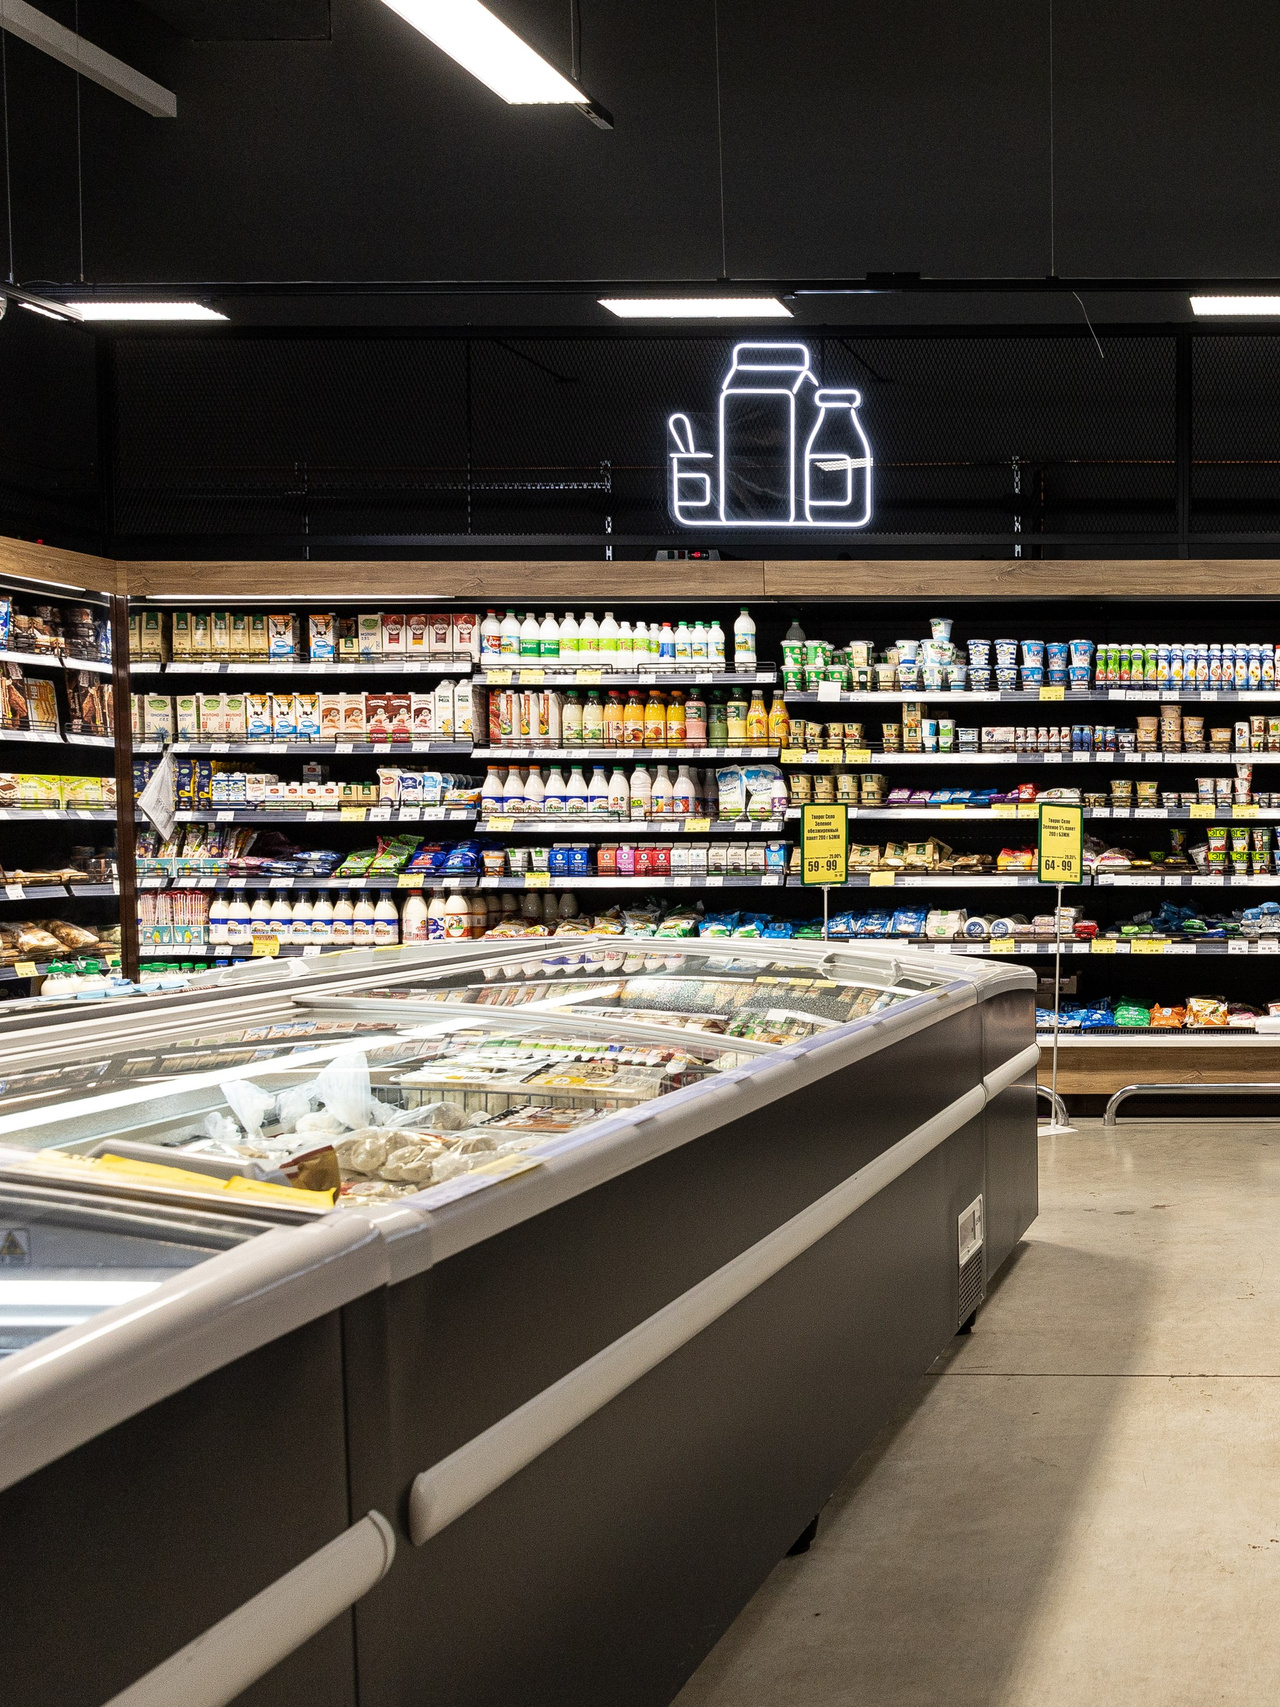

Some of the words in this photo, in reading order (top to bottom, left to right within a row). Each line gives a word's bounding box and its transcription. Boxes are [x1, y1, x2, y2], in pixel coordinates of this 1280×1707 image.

[808, 860, 819, 872] 59
[826, 860, 837, 871] 99
[1045, 859, 1055, 870] 64
[1062, 860, 1072, 871] 99
